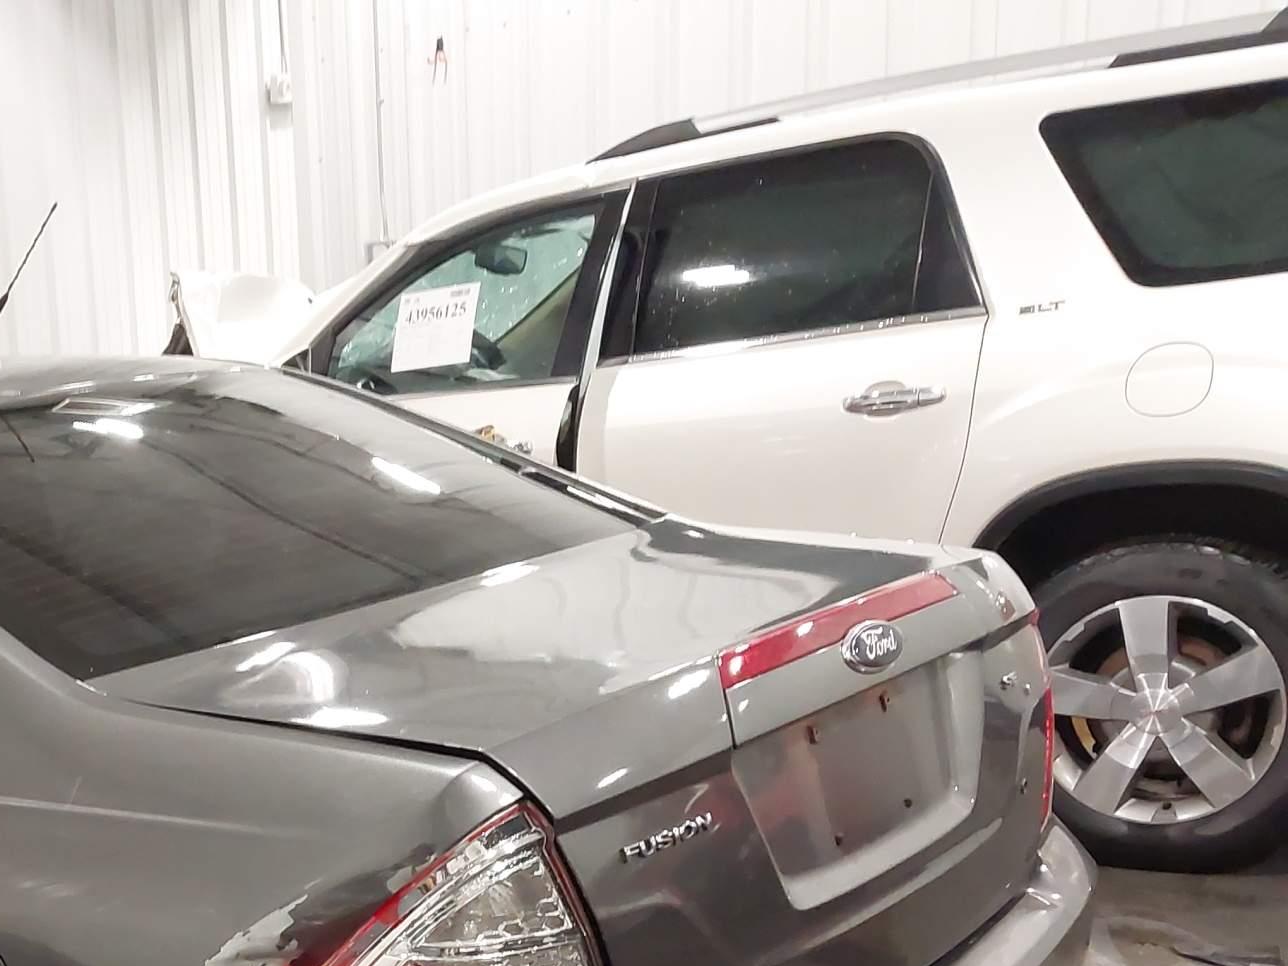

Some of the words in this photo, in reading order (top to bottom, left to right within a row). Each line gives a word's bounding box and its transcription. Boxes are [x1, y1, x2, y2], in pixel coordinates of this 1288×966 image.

[404, 302, 467, 325] 43956125
[860, 626, 897, 660] Ford
[619, 812, 712, 864] FUSION
